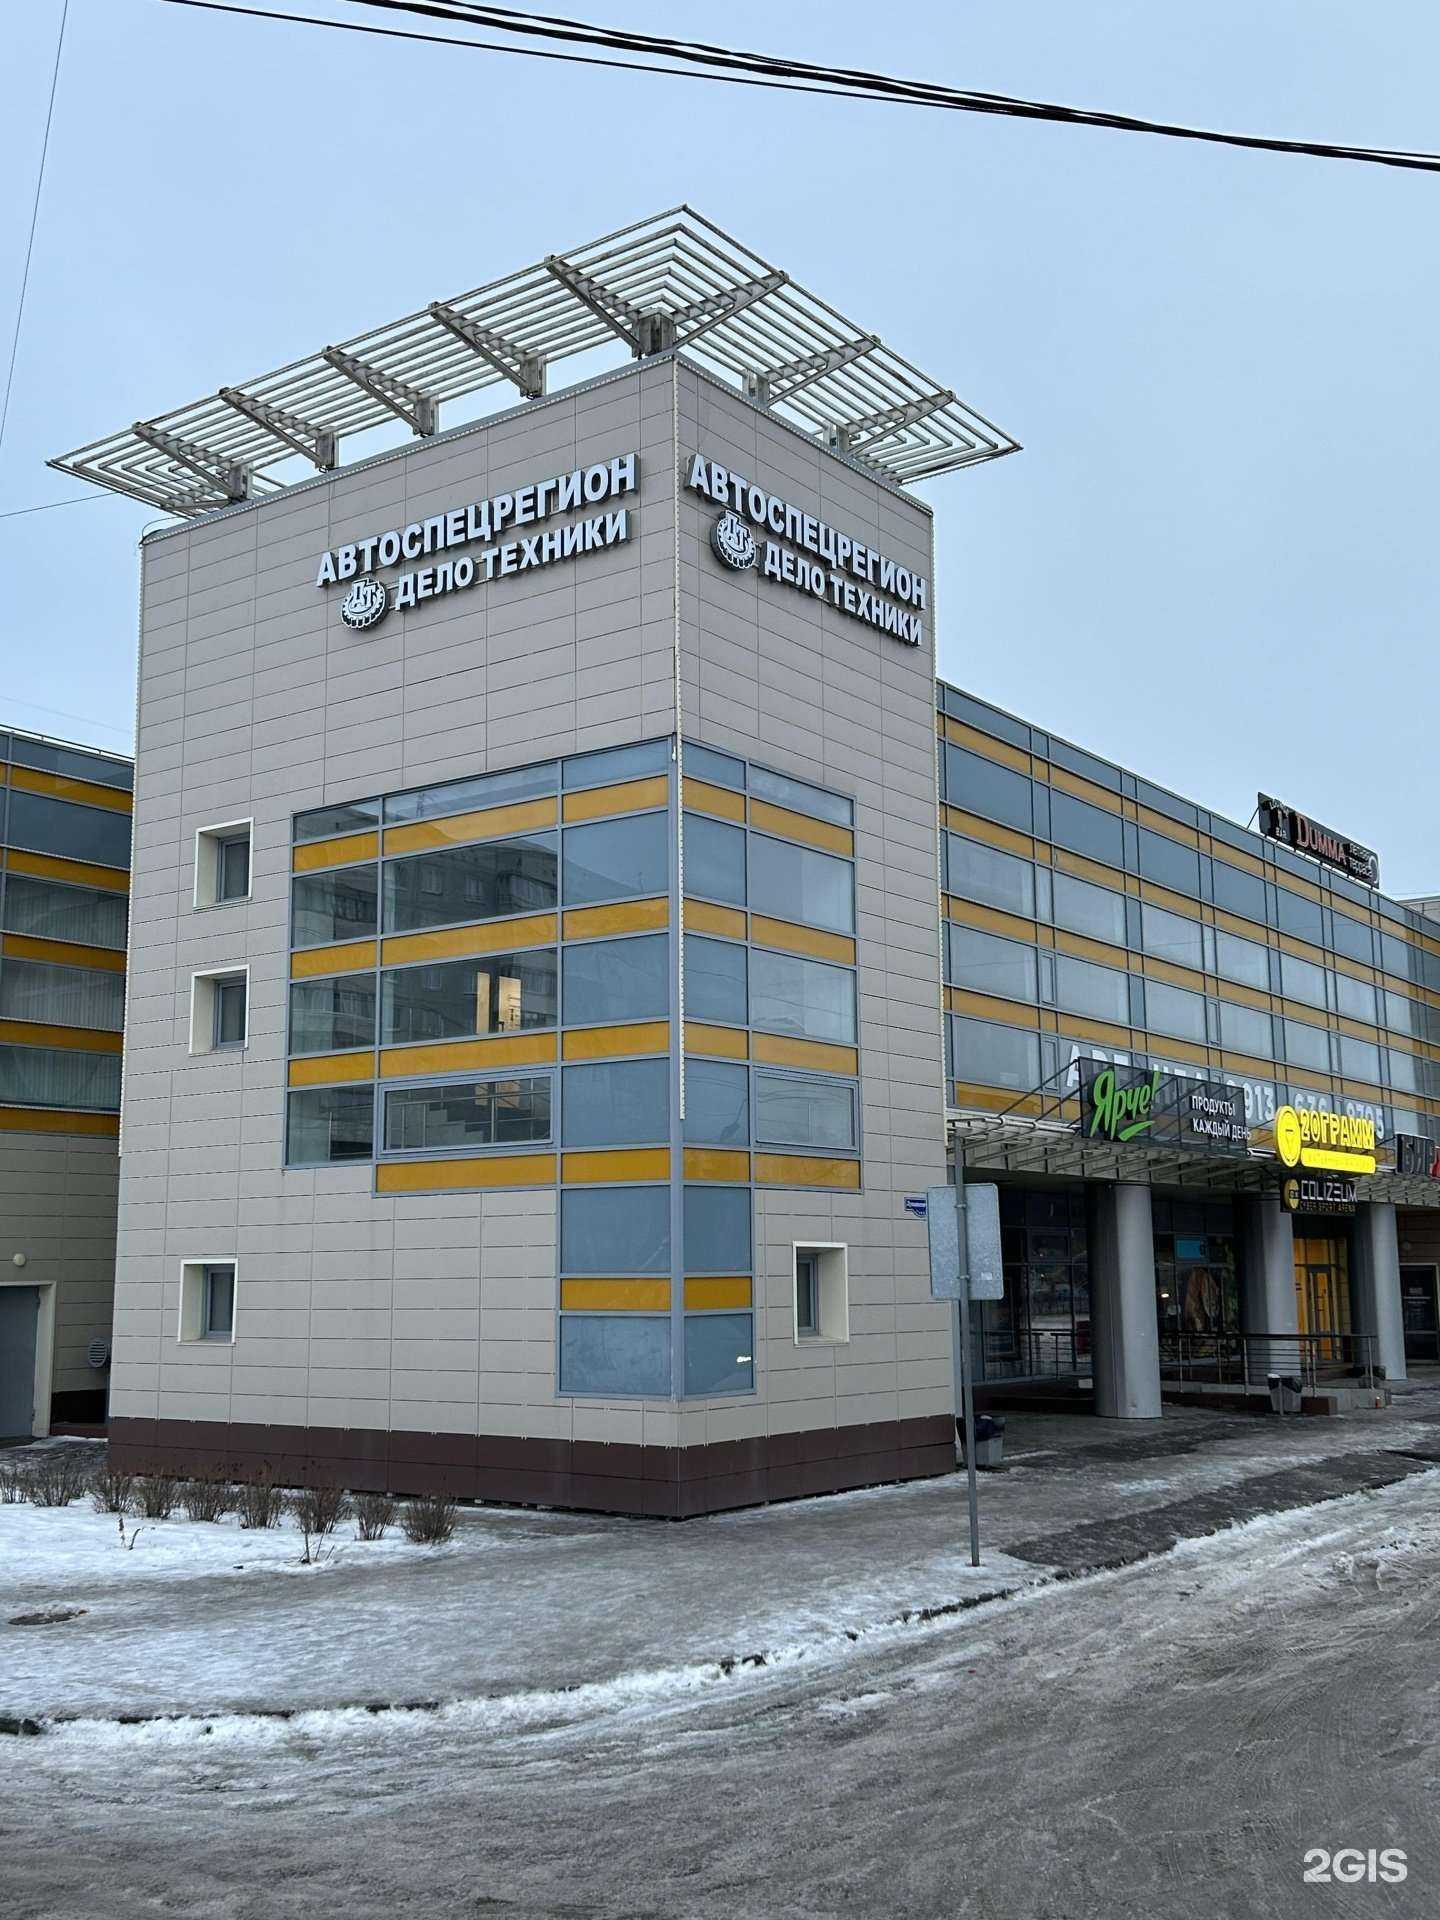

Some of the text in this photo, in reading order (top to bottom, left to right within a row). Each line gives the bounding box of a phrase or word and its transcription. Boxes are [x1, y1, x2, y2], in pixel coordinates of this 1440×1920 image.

[316, 453, 638, 587] АВТОСПЕЦРЕГИОН
[394, 509, 629, 611] ДЕЛО ТЕХНИКИ
[687, 453, 927, 611] АВТОСПЕЦРЕГИОН
[764, 541, 923, 646] ДЕЛО ТЕХНИКИ
[1089, 1070, 1161, 1141] Ярче!
[1191, 1095, 1236, 1117] ПРОДУКТЫ
[1192, 1117, 1252, 1143] КАЖДЫЙ ДЕНЬ
[1301, 1180, 1358, 1203] COLIZEUM
